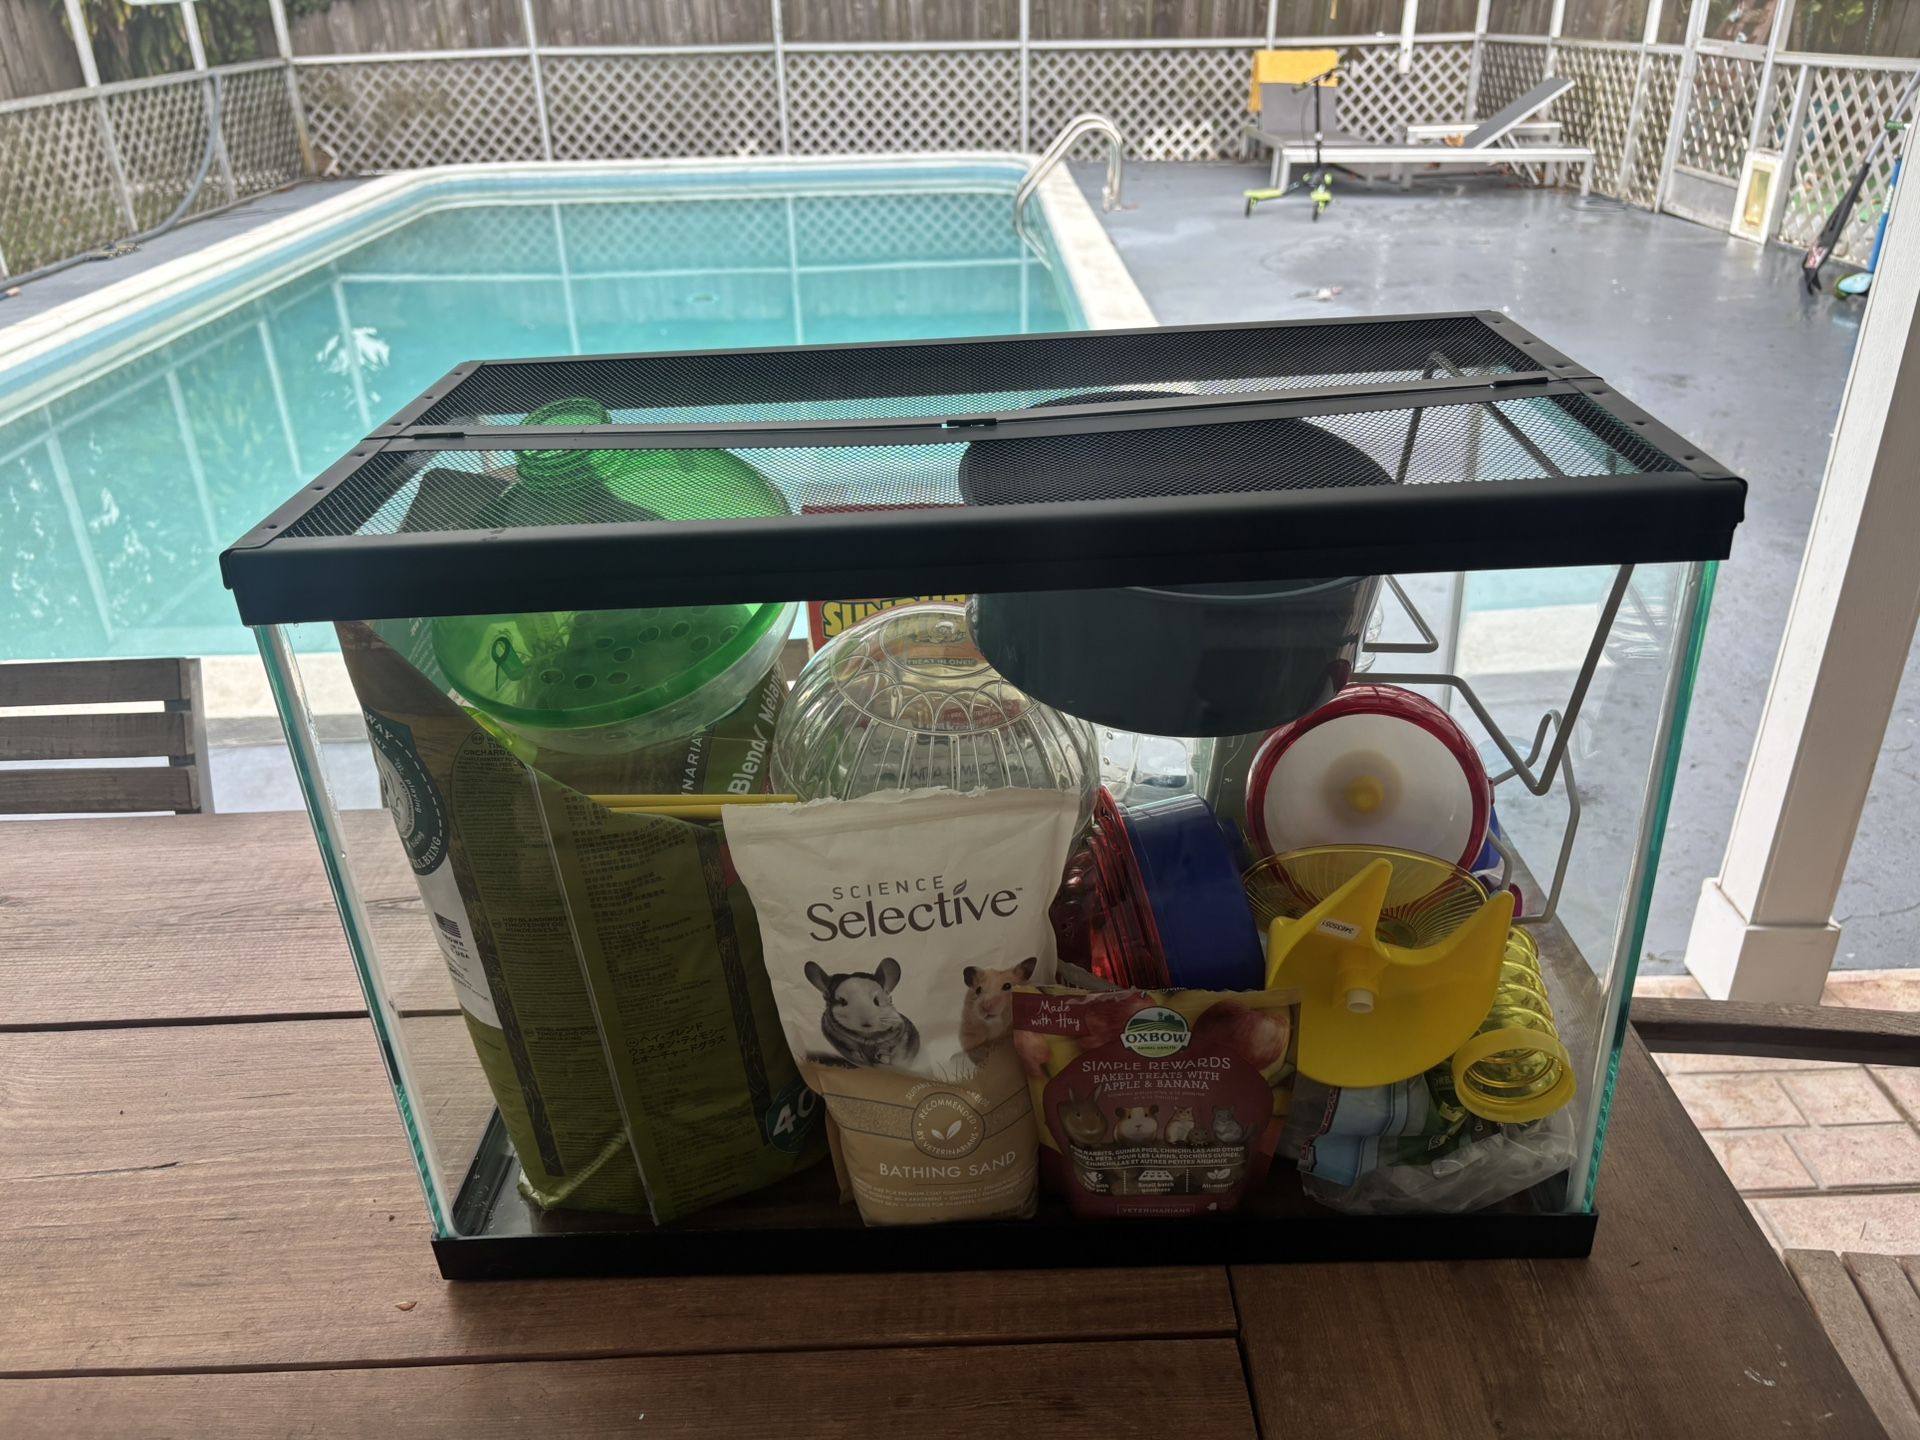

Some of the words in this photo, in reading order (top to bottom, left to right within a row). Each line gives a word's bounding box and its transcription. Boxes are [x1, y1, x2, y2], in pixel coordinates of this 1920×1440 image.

[727, 738, 768, 794] Blend
[405, 779, 423, 813] playing
[832, 875, 944, 900] SCIENCE
[806, 879, 1019, 942] Selective
[1036, 1000, 1071, 1014] Made
[1031, 1013, 1052, 1027] with
[1056, 1013, 1080, 1032] Hay
[1125, 1032, 1187, 1043] OXBOW
[1082, 1060, 1142, 1072] SIMPLE
[1148, 1056, 1231, 1070] REWARDS
[1093, 1072, 1134, 1084] BAKED
[1137, 1071, 1183, 1080] TREATS
[1187, 1071, 1220, 1081] WITH
[1103, 1080, 1141, 1091] APPLE
[1144, 1080, 1153, 1088] &
[1157, 1079, 1210, 1091] BANANA
[918, 1098, 977, 1125] RECOMMENDED
[923, 1132, 979, 1155] VETERINARIANS
[879, 1162, 962, 1179] BATHING
[969, 1151, 1016, 1176] SAND
